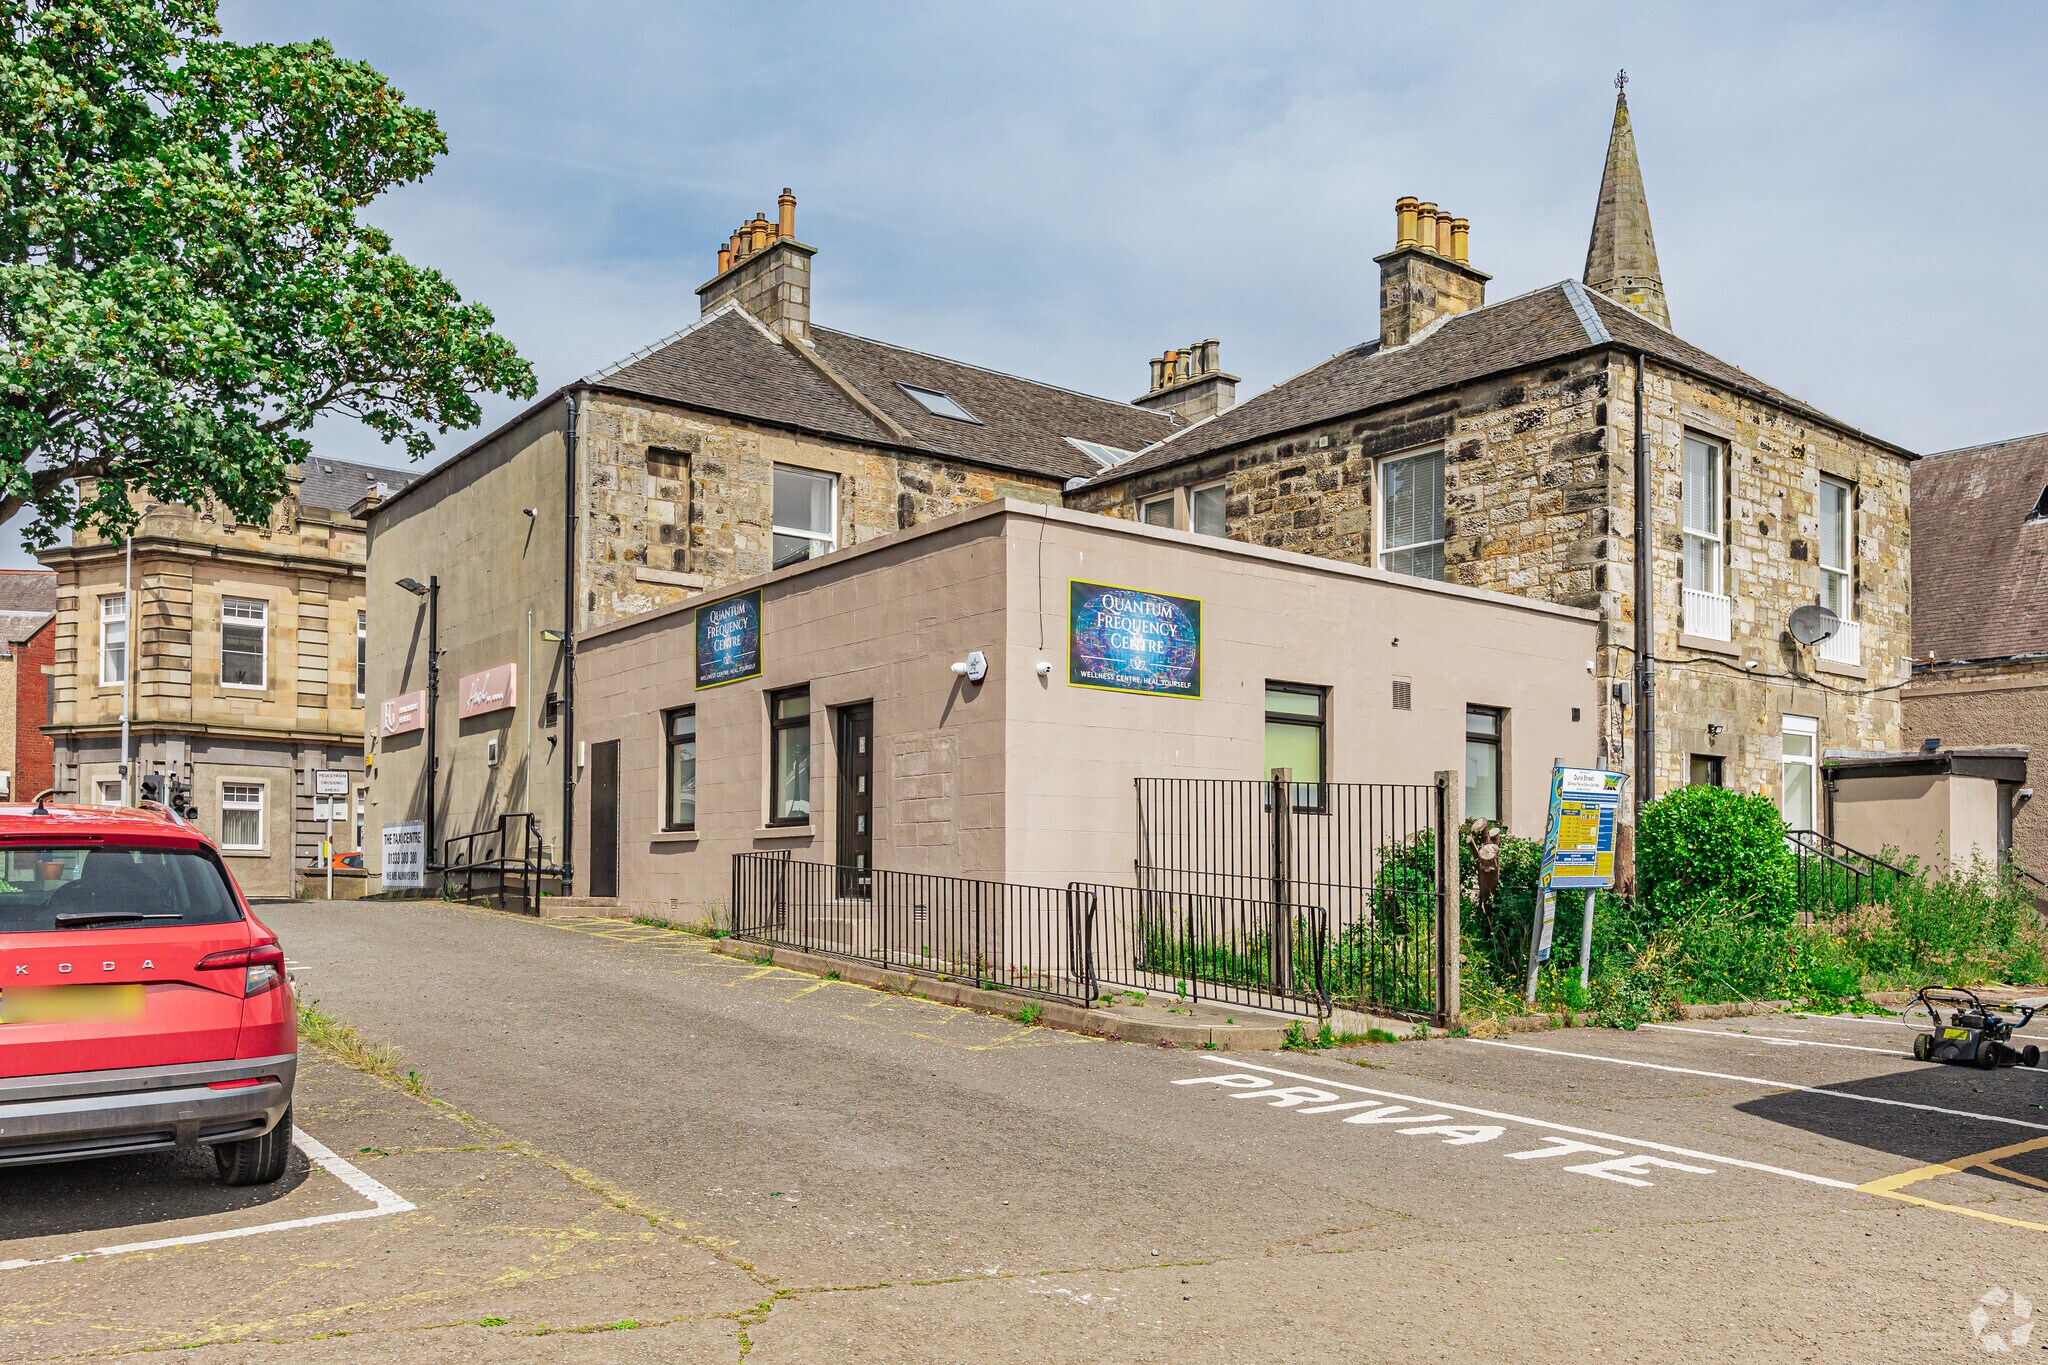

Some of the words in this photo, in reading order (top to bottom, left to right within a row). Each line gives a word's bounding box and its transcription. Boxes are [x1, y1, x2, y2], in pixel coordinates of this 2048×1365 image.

[709, 603, 745, 625] QUANTUM
[1102, 594, 1173, 619] QUANTUM
[707, 617, 748, 639] FREQUENCY
[1097, 612, 1178, 637] FREQUENCY
[714, 635, 741, 652] CENTRE
[1111, 633, 1165, 654] CENTRE
[1080, 670, 1115, 681] WELLNESS
[1143, 677, 1159, 686] HEAL
[1160, 679, 1192, 689] YOURSELF
[384, 833, 392, 845] THE
[404, 831, 421, 844] CENTRE
[1170, 1073, 1718, 1188] PRIVATE
